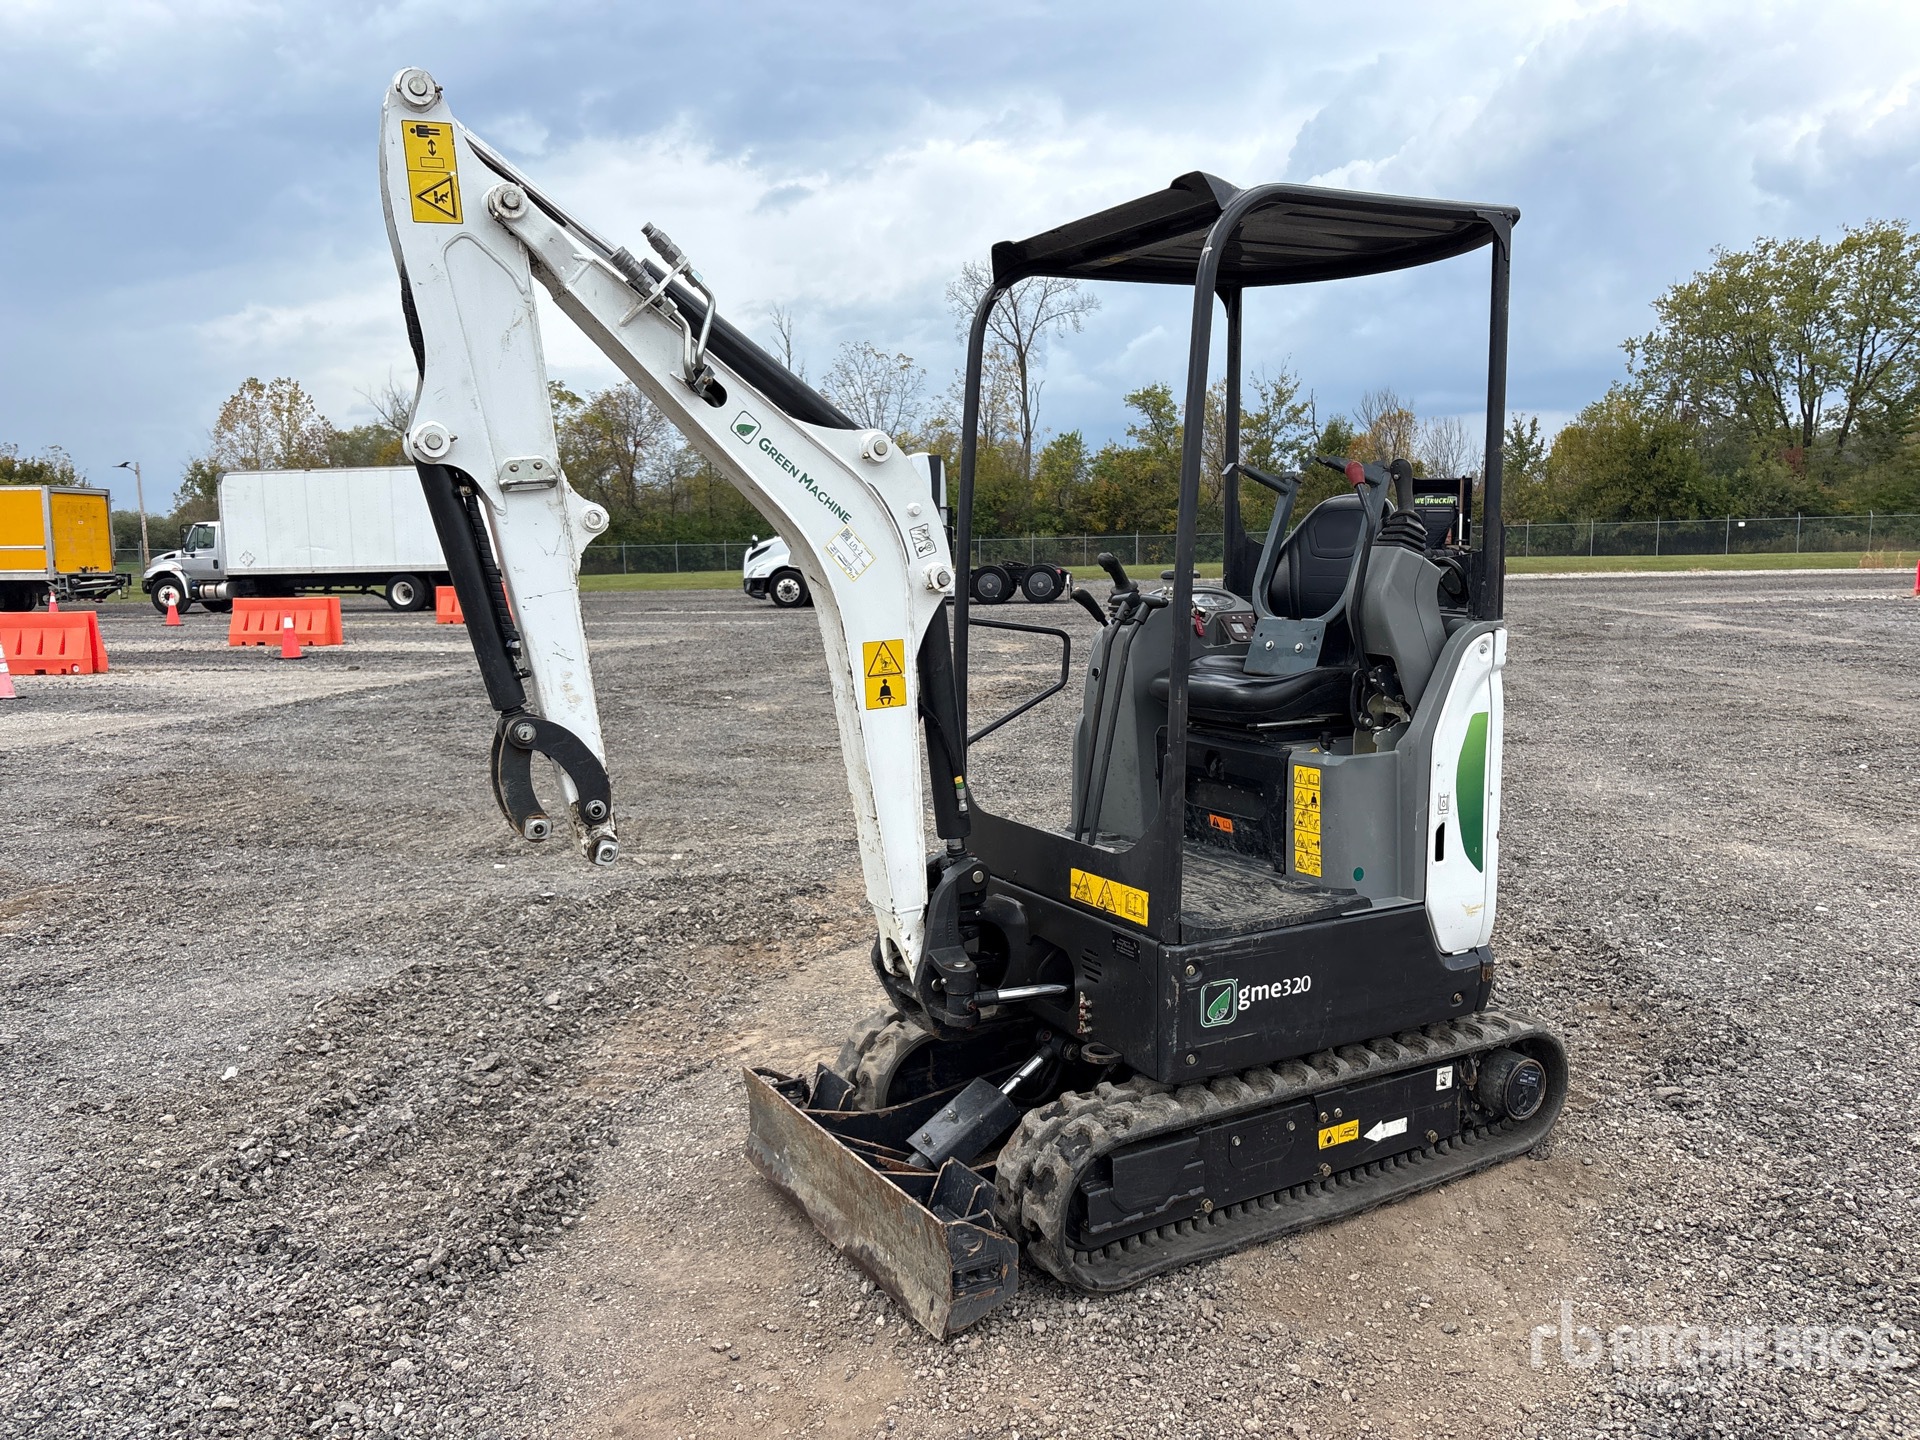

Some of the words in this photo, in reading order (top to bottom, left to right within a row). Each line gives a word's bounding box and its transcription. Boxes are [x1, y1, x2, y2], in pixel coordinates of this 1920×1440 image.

[759, 437, 800, 478] GREEN
[799, 472, 853, 525] MACHINE
[1237, 975, 1312, 1011] gme320
